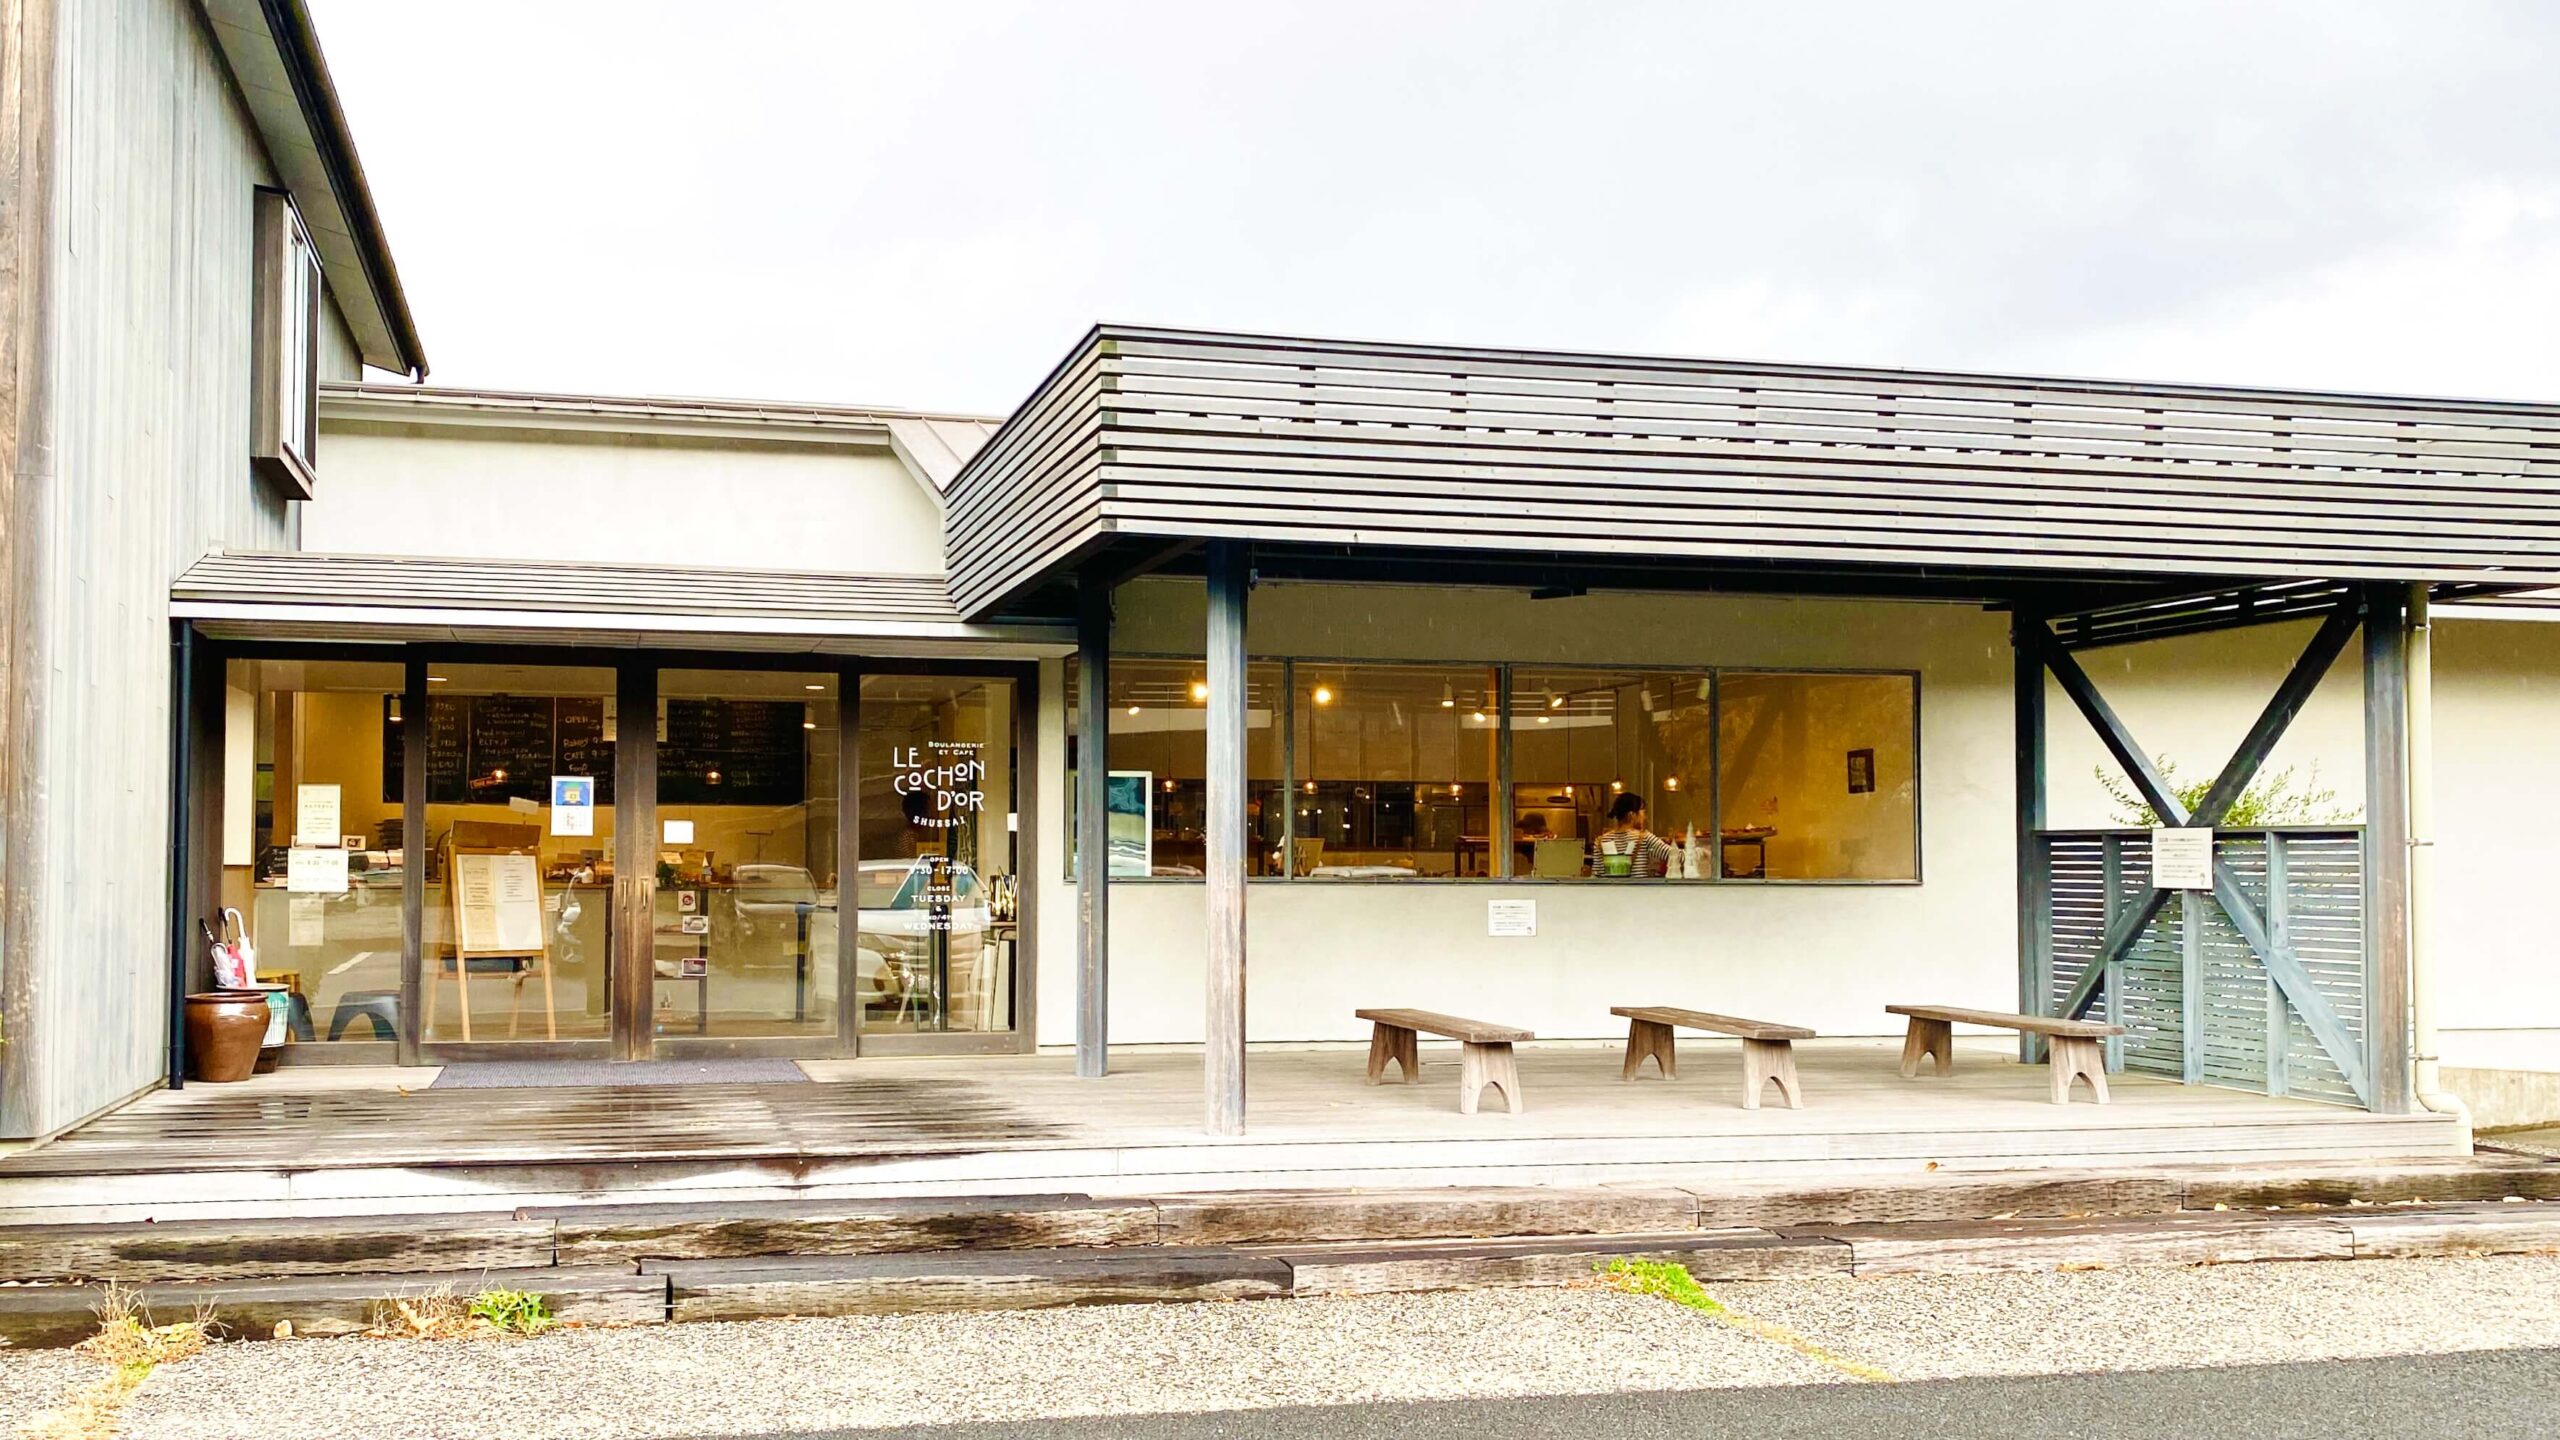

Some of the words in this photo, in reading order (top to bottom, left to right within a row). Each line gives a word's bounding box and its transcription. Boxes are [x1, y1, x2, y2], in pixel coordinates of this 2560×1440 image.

[894, 746, 921, 768] LE
[937, 790, 985, 811] D'OR
[913, 815, 966, 828] SHUSSAI
[911, 894, 967, 903] TUESDAY
[902, 922, 974, 930] WEDNESDAY
